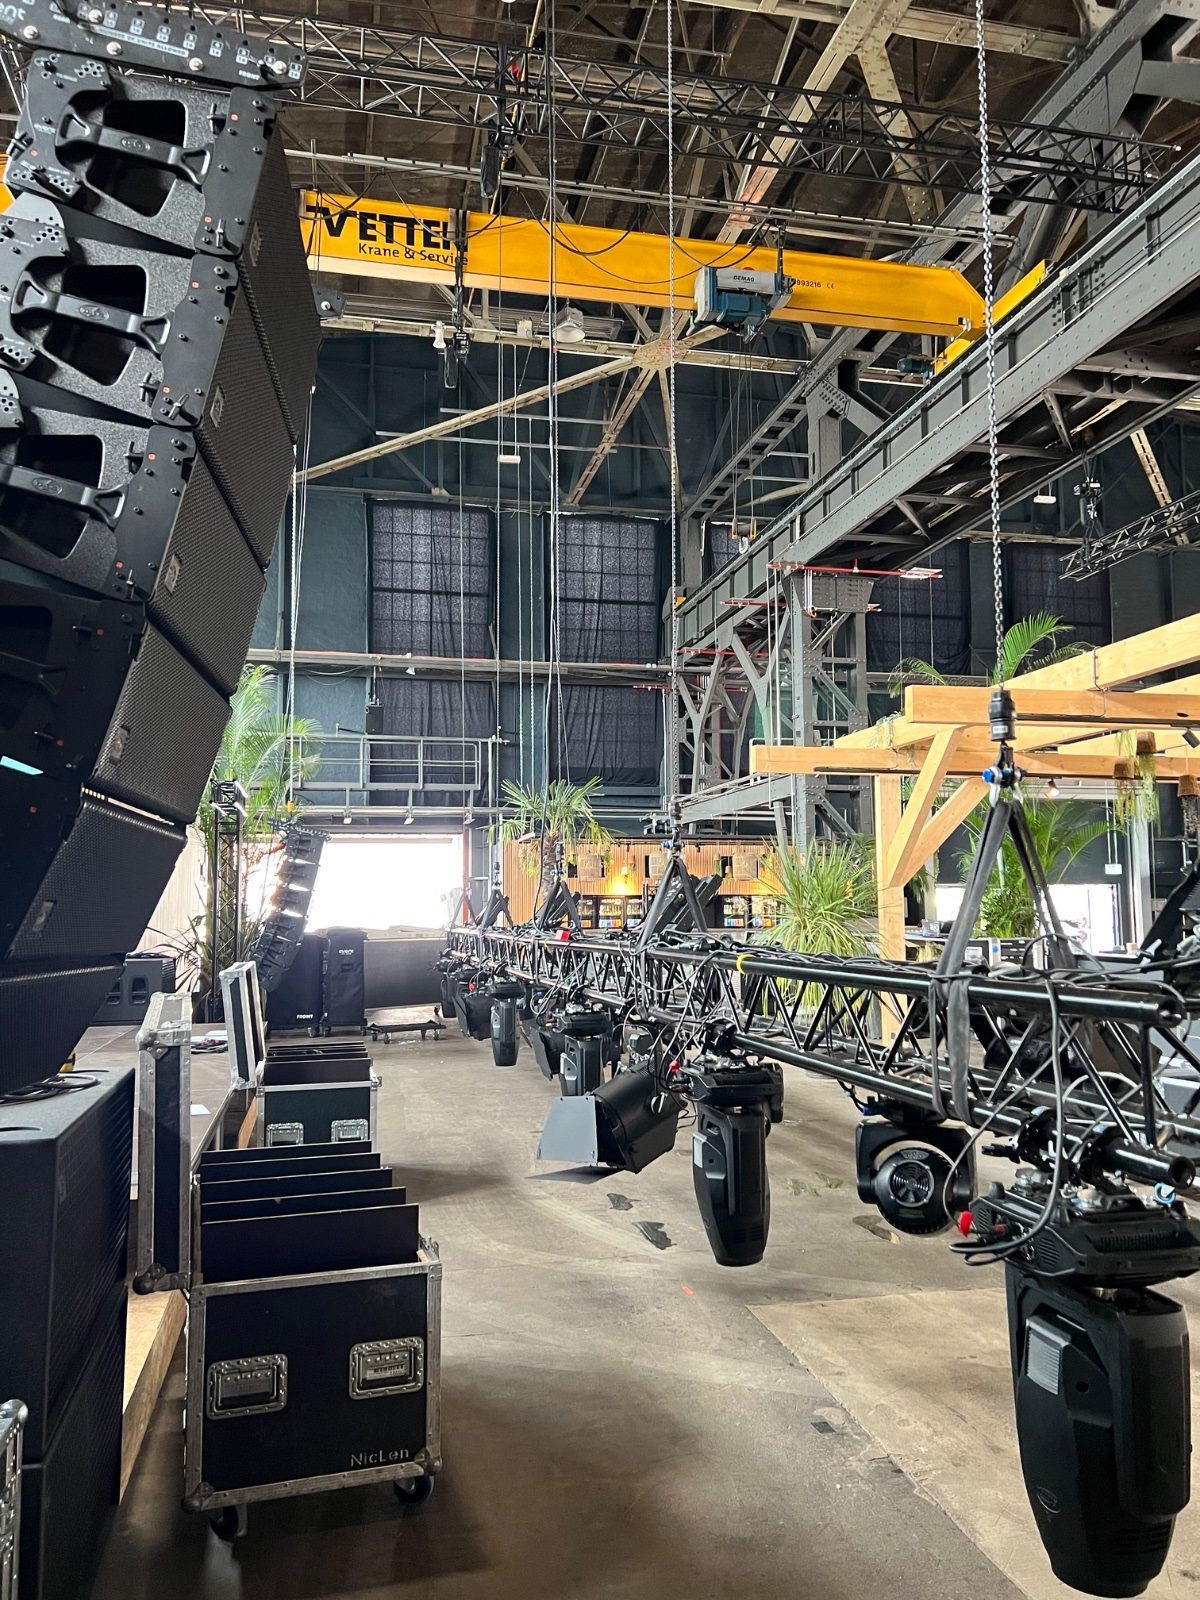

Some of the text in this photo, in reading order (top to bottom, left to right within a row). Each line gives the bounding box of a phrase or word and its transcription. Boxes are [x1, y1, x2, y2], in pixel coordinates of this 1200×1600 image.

[239, 70, 260, 80] FRONT
[358, 243, 400, 258] Krane
[404, 249, 415, 260] &
[350, 1449, 409, 1467] NicLen
